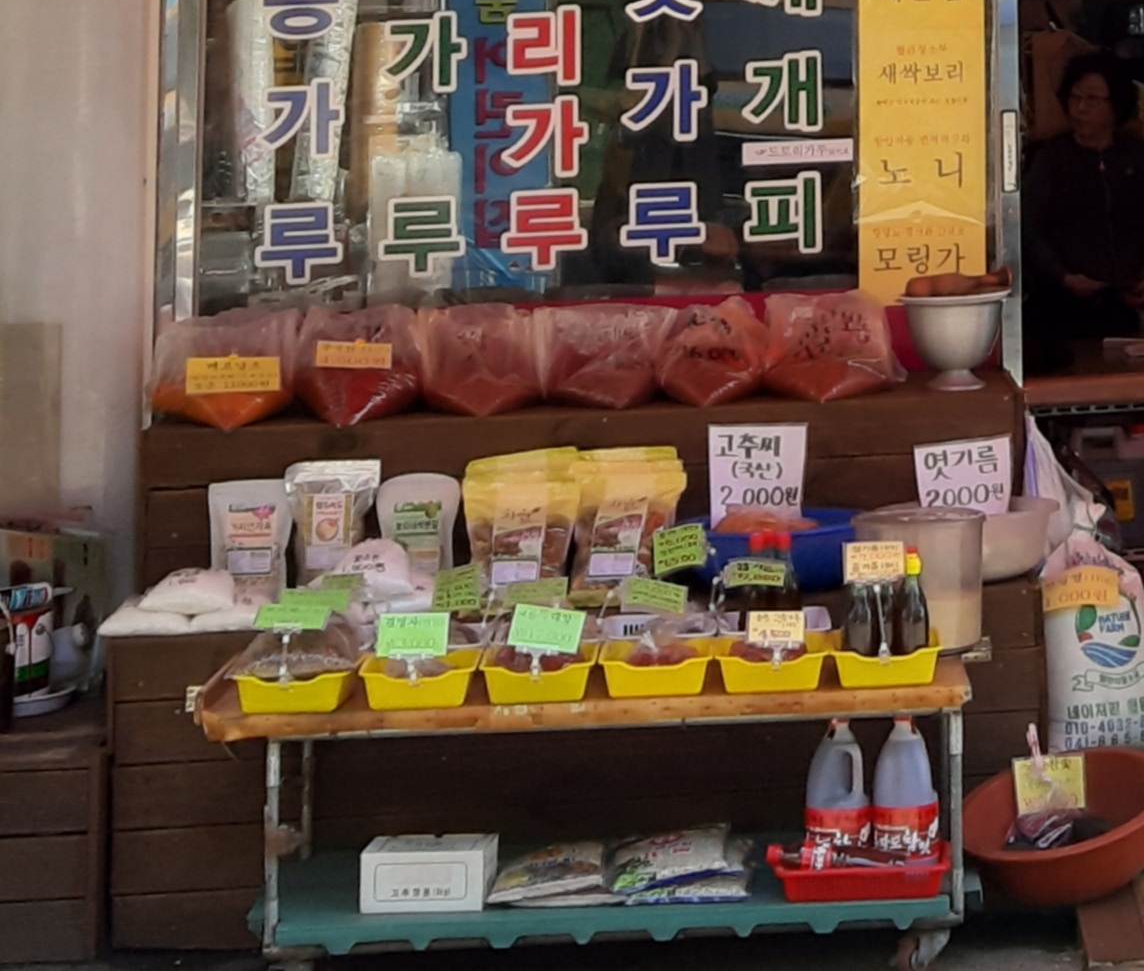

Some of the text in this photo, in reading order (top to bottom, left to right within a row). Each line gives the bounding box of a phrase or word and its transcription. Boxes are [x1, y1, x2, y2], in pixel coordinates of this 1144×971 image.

[878, 59, 964, 85] 새싹보리
[873, 242, 966, 275] 모링가
[715, 433, 782, 458] 고추씨
[731, 460, 783, 481] (국산)
[924, 445, 999, 481] 엿기름
